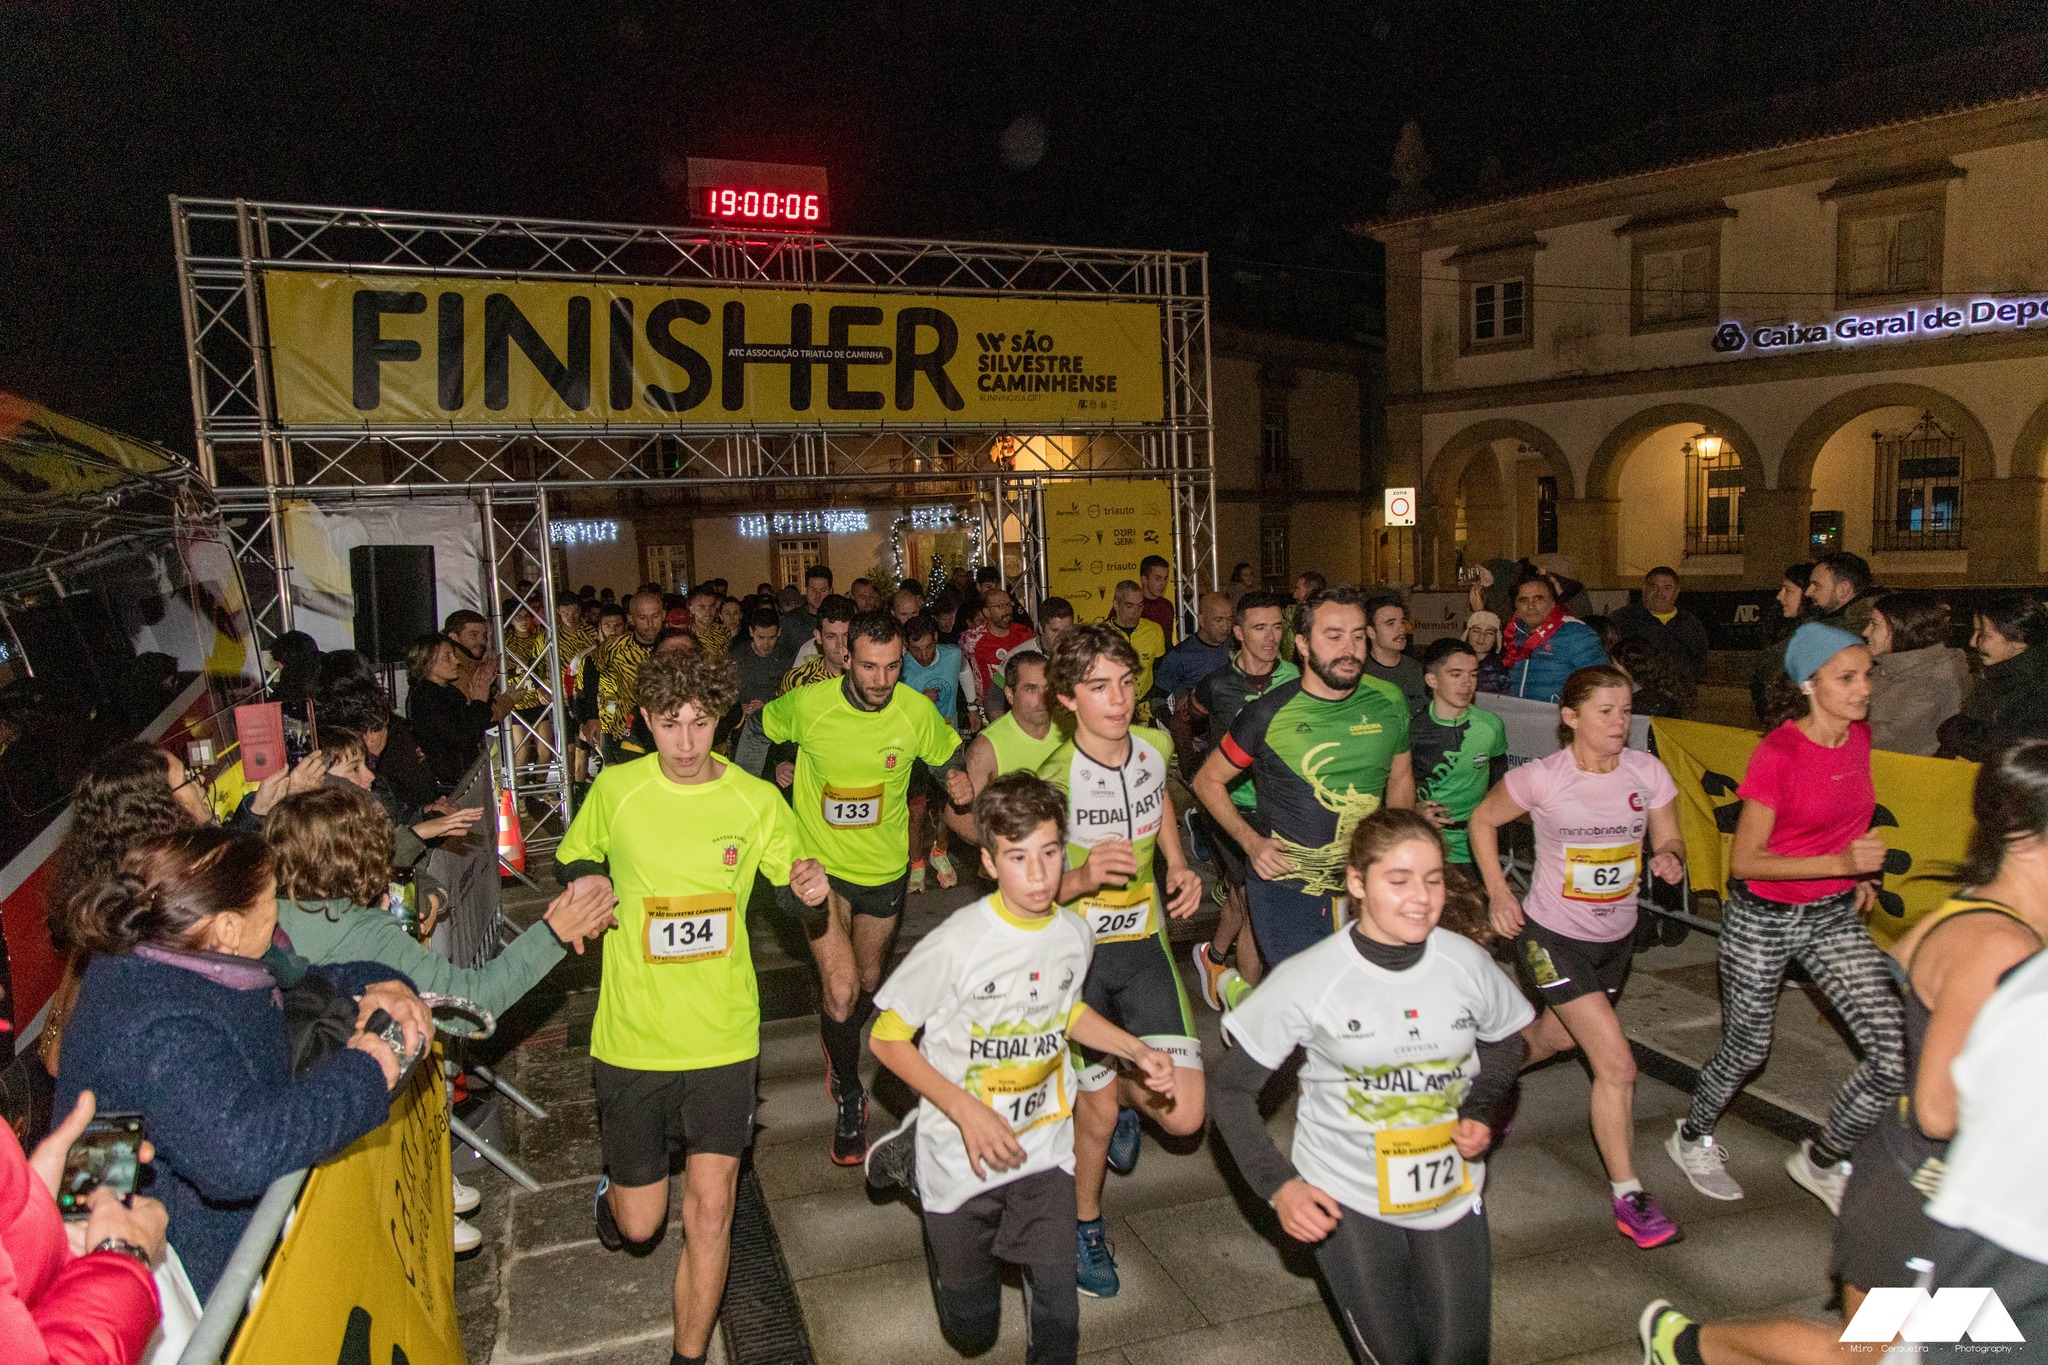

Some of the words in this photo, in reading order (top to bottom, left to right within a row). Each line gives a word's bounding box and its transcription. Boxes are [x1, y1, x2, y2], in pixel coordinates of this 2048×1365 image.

[711, 189, 819, 220] 19:00:06
[1752, 325, 1828, 349] Caixa
[1834, 311, 1916, 339] Geral
[1923, 306, 1962, 330] de
[352, 289, 966, 412] FINISHER
[1010, 329, 1054, 353] SÃO
[728, 348, 745, 357] ATC
[746, 347, 799, 360] ASSOCIAÇÃO
[801, 349, 833, 359] TRIATLO
[834, 350, 845, 359] DE
[846, 351, 884, 359] CAMINHA
[977, 353, 1084, 373] SILVESTRE
[977, 373, 1117, 393] CAMINHENSE
[1104, 506, 1135, 516] triauto
[1107, 561, 1137, 571] triauto
[834, 803, 870, 819] 133
[1559, 825, 1628, 836] minhobrinde
[1594, 867, 1621, 887] 62
[666, 910, 694, 918] SILVESTRE
[695, 906, 732, 915] CAMINHENSE
[662, 918, 713, 947] 134
[1096, 912, 1140, 934] 205
[1408, 1154, 1454, 1193] 172
